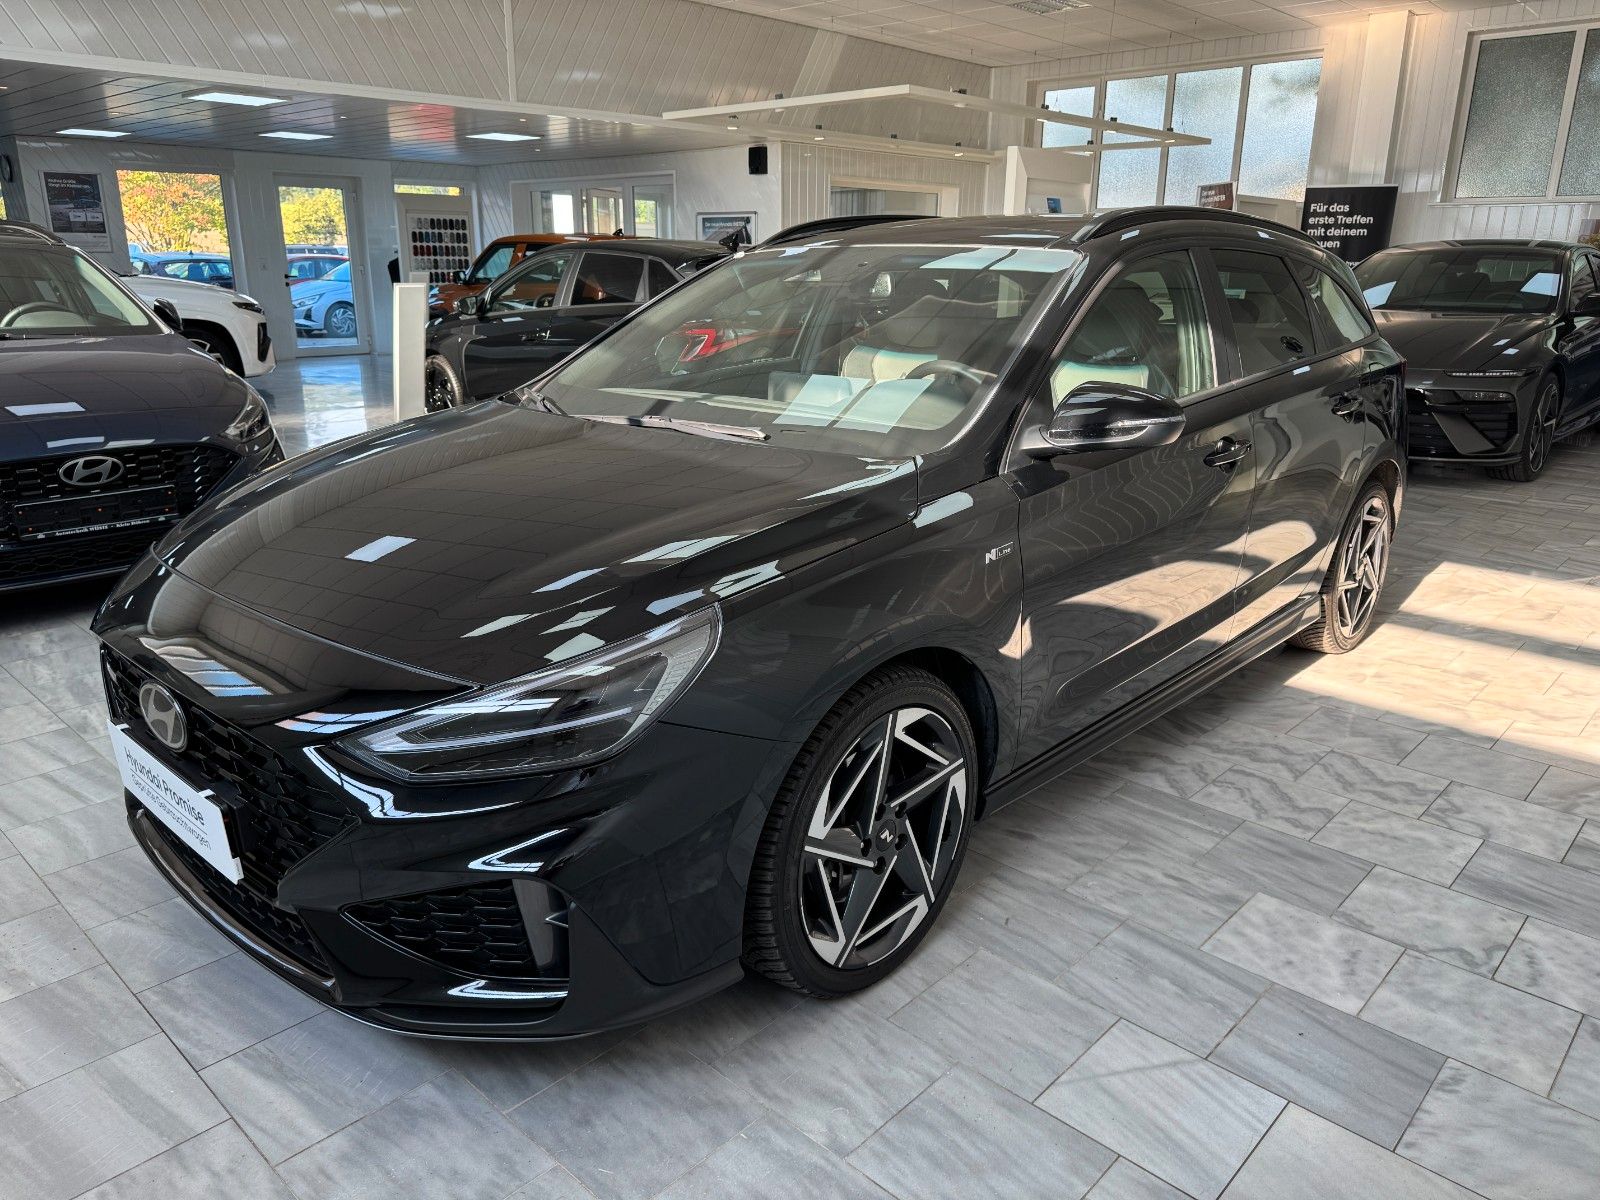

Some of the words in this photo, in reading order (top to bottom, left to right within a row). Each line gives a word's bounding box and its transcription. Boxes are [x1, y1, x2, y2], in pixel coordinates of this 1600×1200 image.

[1310, 203, 1328, 213] Für
[1329, 203, 1350, 212] das
[1308, 215, 1335, 224] erste
[1336, 214, 1374, 224] Treffen
[1307, 227, 1326, 236] mit
[1326, 227, 1368, 236] deinem
[1317, 240, 1341, 248] uen
[124, 746, 163, 791] Hyundai
[162, 779, 205, 826] Promise
